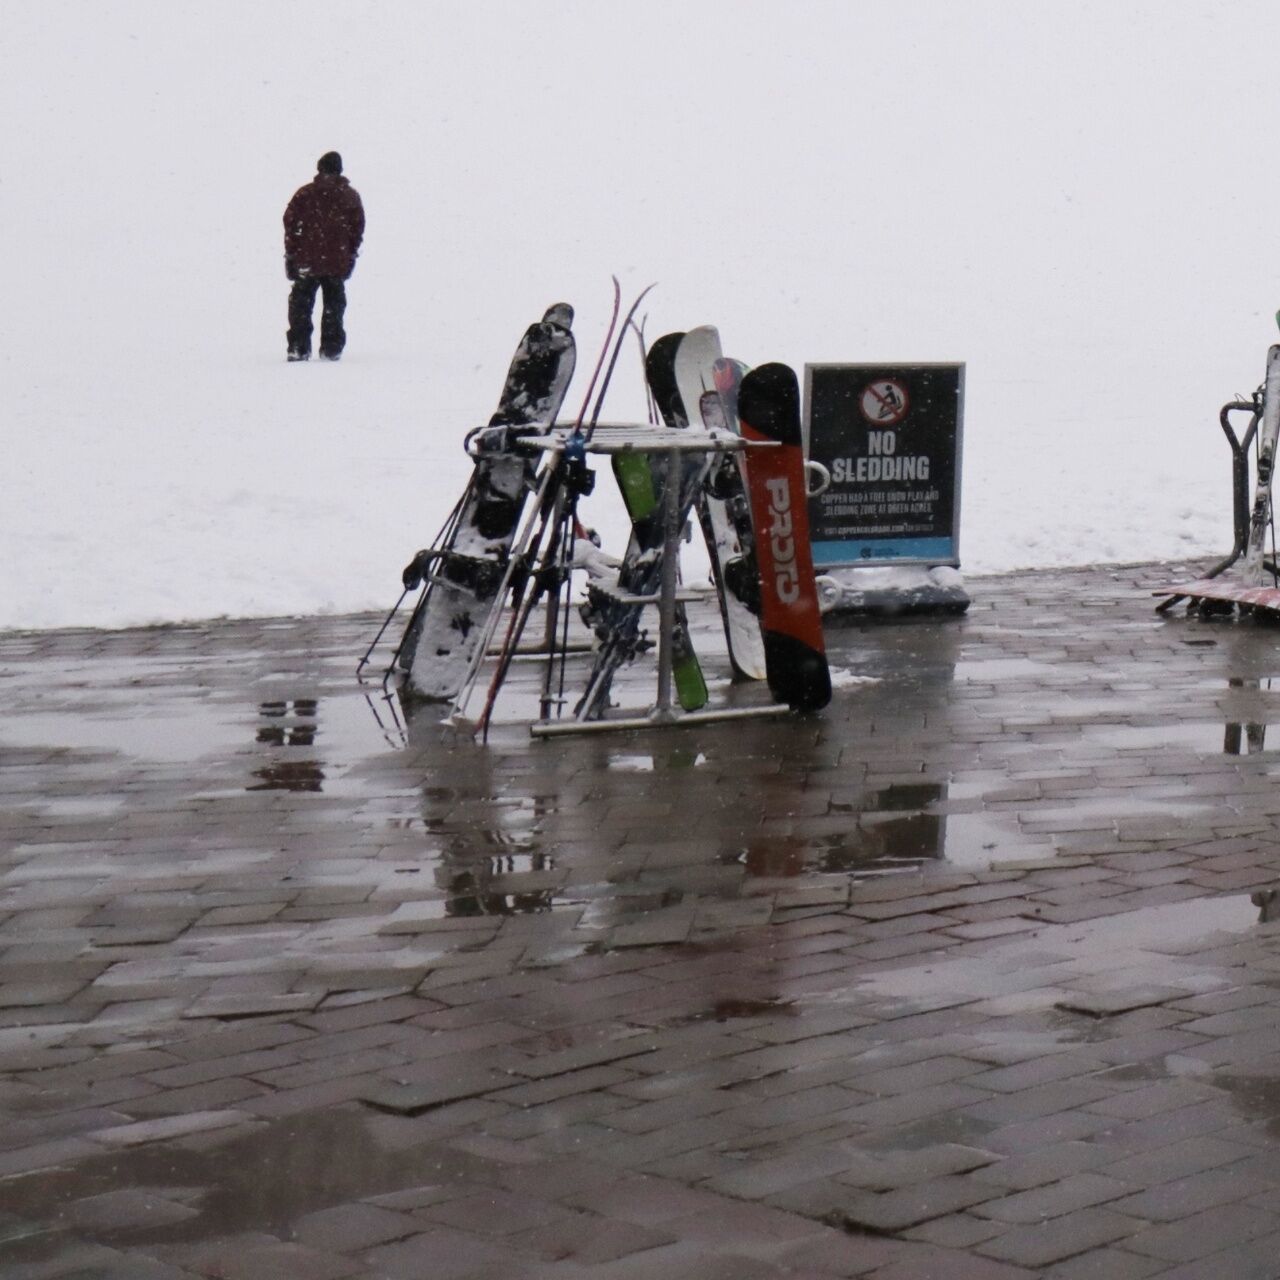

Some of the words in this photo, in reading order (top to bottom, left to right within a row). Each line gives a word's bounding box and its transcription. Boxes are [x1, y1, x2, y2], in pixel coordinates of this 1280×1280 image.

[868, 430, 896, 456] NO
[832, 456, 930, 483] SLEDDING
[821, 493, 848, 505] COPPER
[907, 490, 925, 501] PLAY
[766, 477, 800, 604] PROTO
